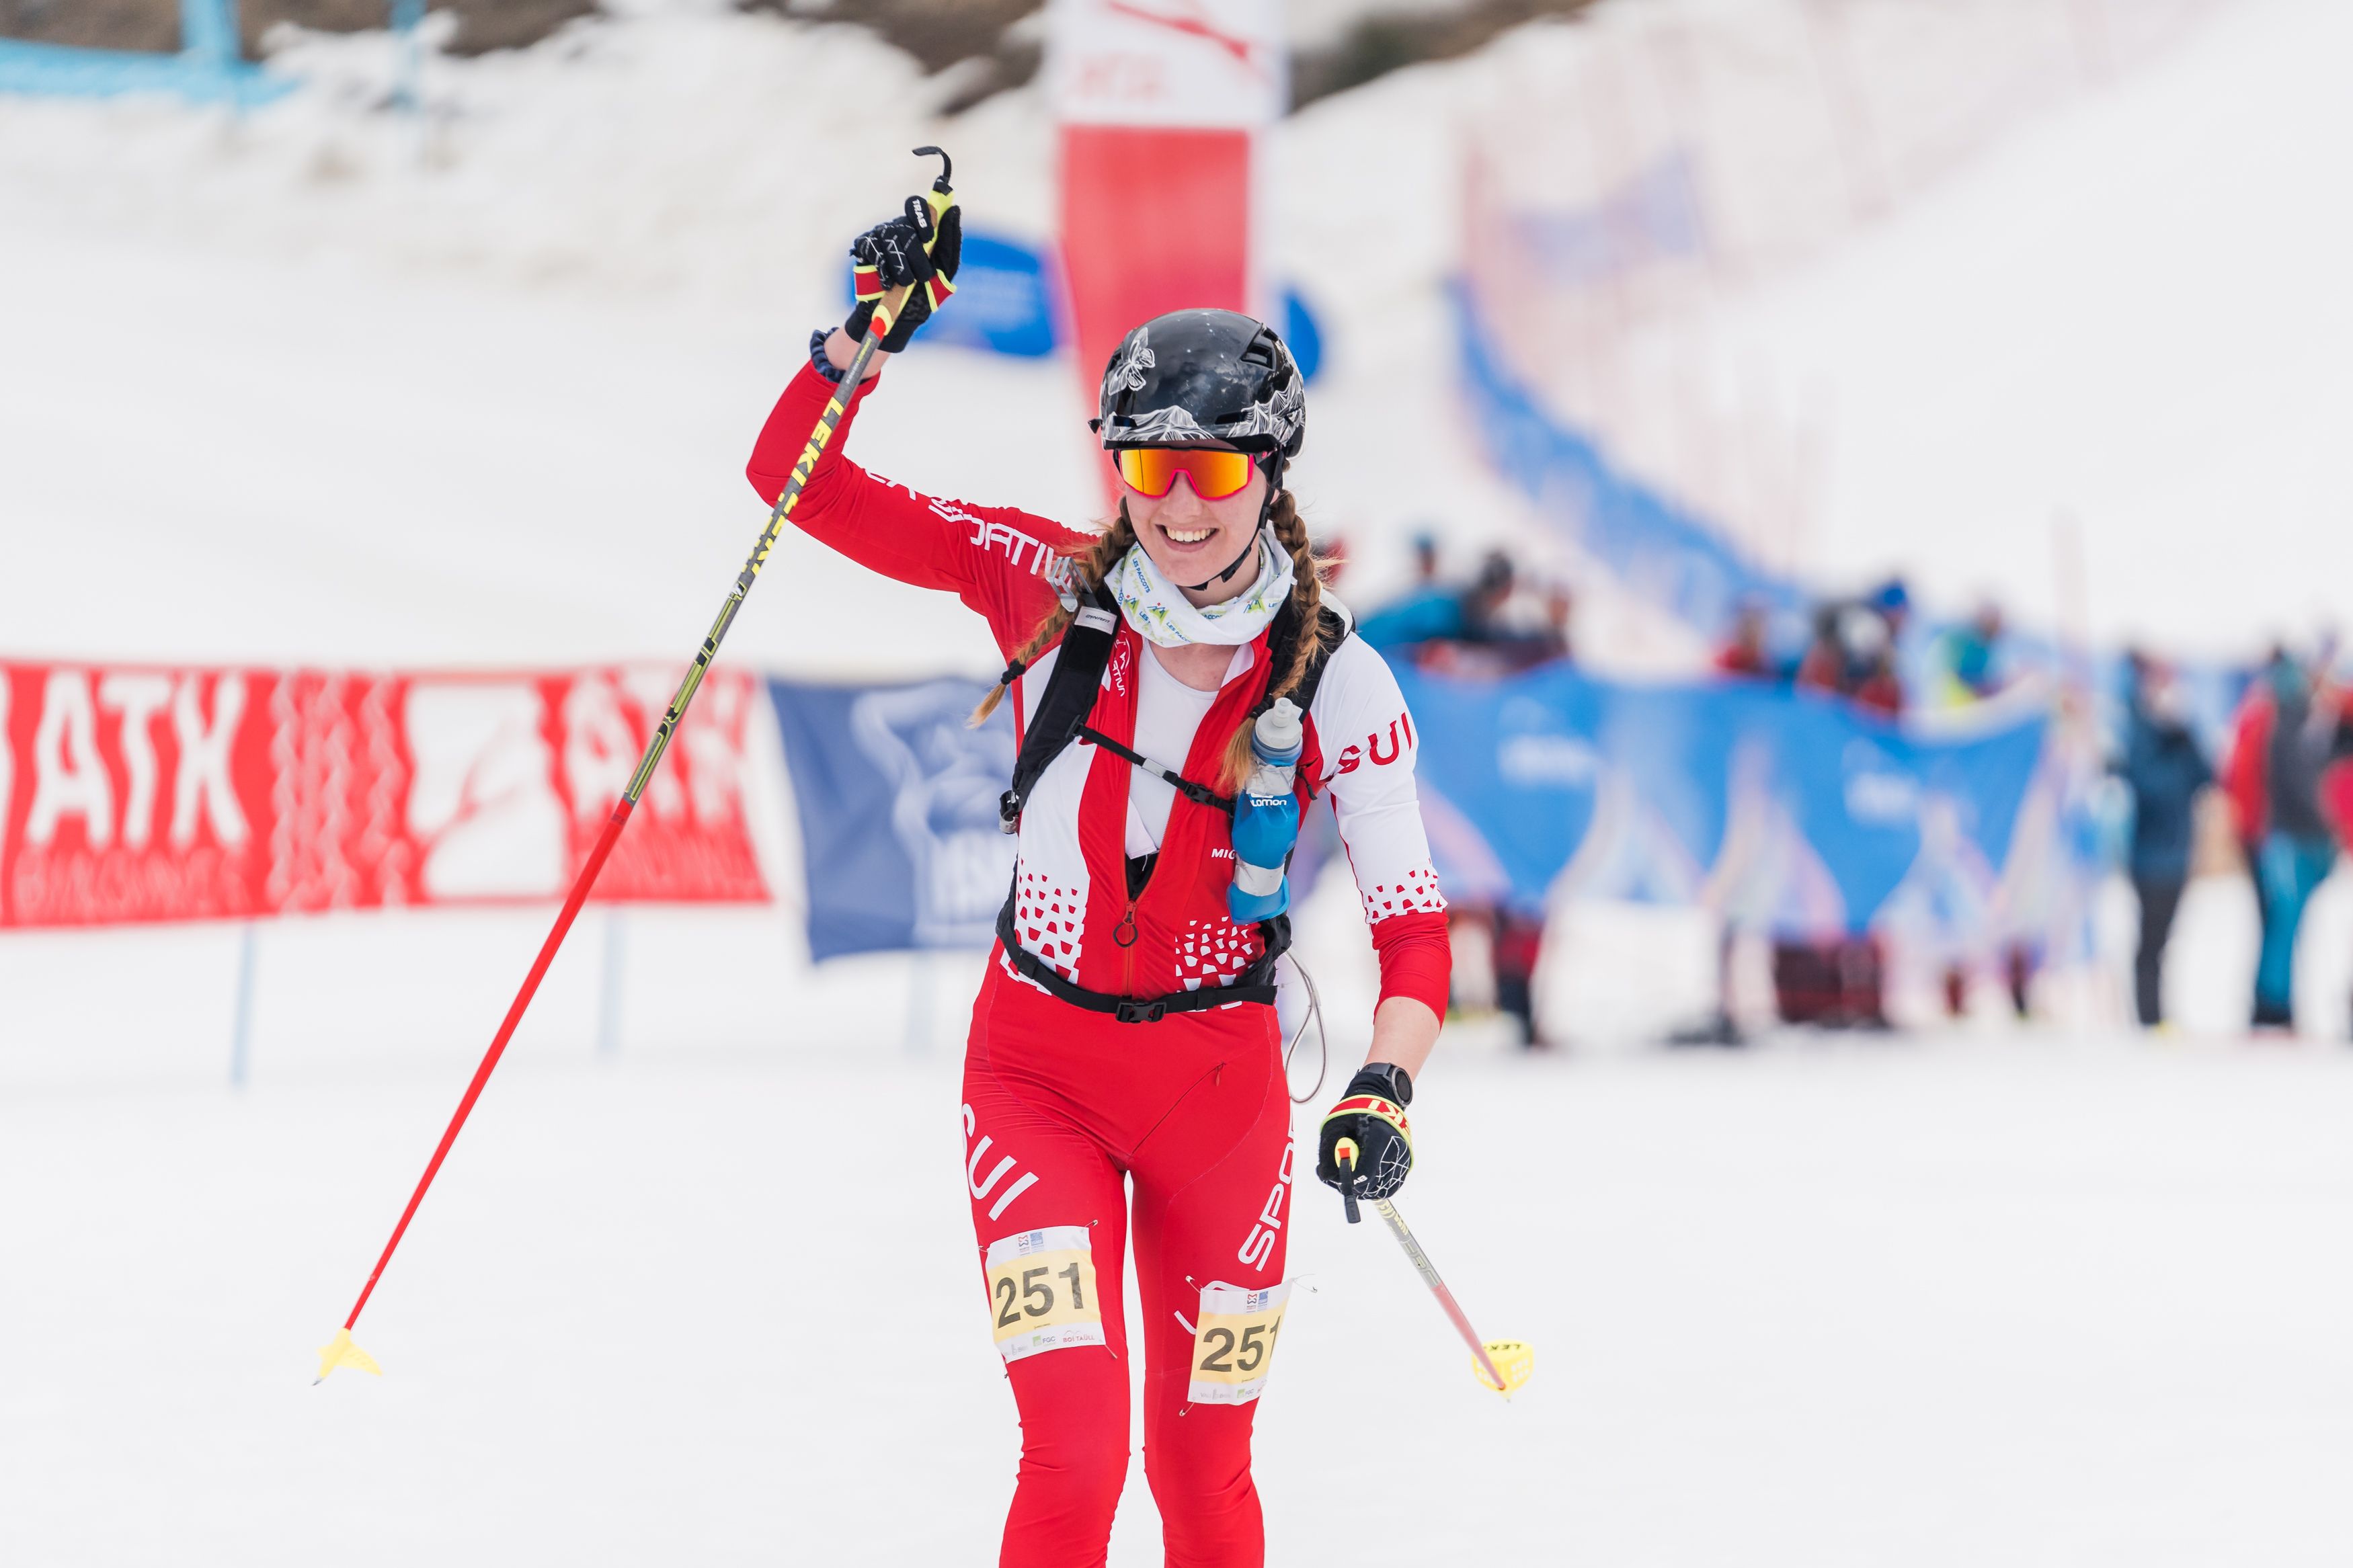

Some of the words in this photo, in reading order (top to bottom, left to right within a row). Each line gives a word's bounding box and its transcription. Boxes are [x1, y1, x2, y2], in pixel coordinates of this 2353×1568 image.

[912, 199, 928, 229] TRAB
[790, 397, 846, 488] LEKI
[1136, 568, 1151, 593] PACCOTS
[1085, 614, 1111, 623] DYNAFIT
[1139, 611, 1149, 621] LES
[1166, 622, 1176, 631] LES
[1338, 712, 1412, 774] SUI
[26, 670, 251, 850] ATK
[961, 1103, 1040, 1222] SUI
[1353, 1175, 1368, 1186] AB
[996, 1262, 1084, 1329] 251
